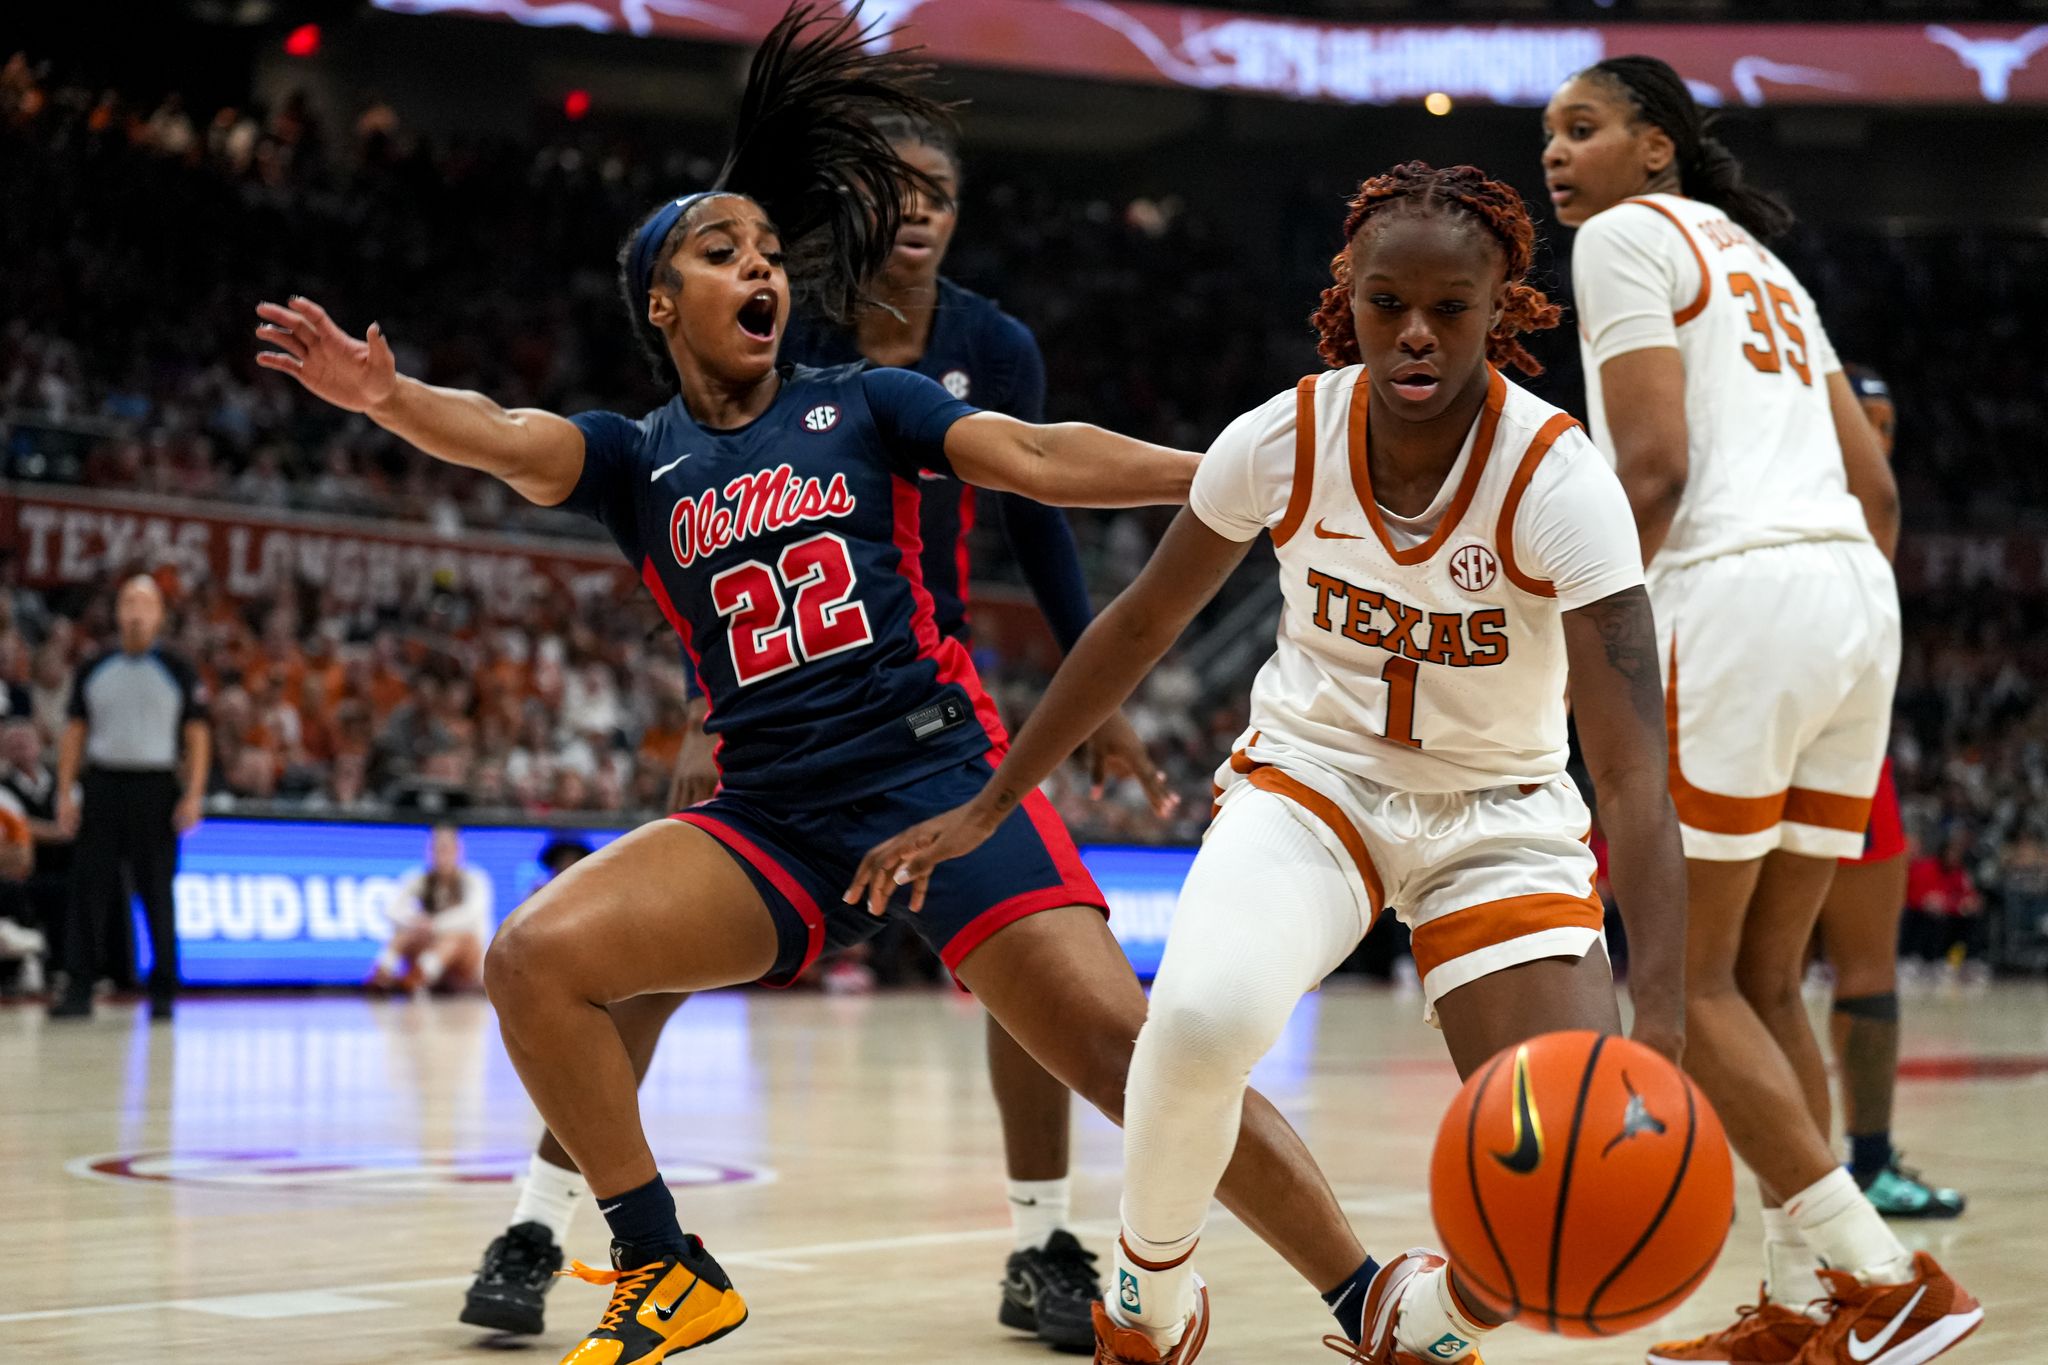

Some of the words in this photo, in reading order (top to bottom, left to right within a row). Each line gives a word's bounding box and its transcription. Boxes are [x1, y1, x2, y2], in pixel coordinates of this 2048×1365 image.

[1727, 271, 1813, 388] 35
[804, 406, 837, 431] SEC
[670, 487, 732, 569] Ole
[723, 463, 856, 542] Miss
[710, 531, 874, 688] 22
[1450, 545, 1497, 591] SEC
[1307, 567, 1510, 668] TEXAS
[947, 706, 957, 719] S
[1375, 655, 1425, 750] 1
[173, 872, 301, 940] BUD
